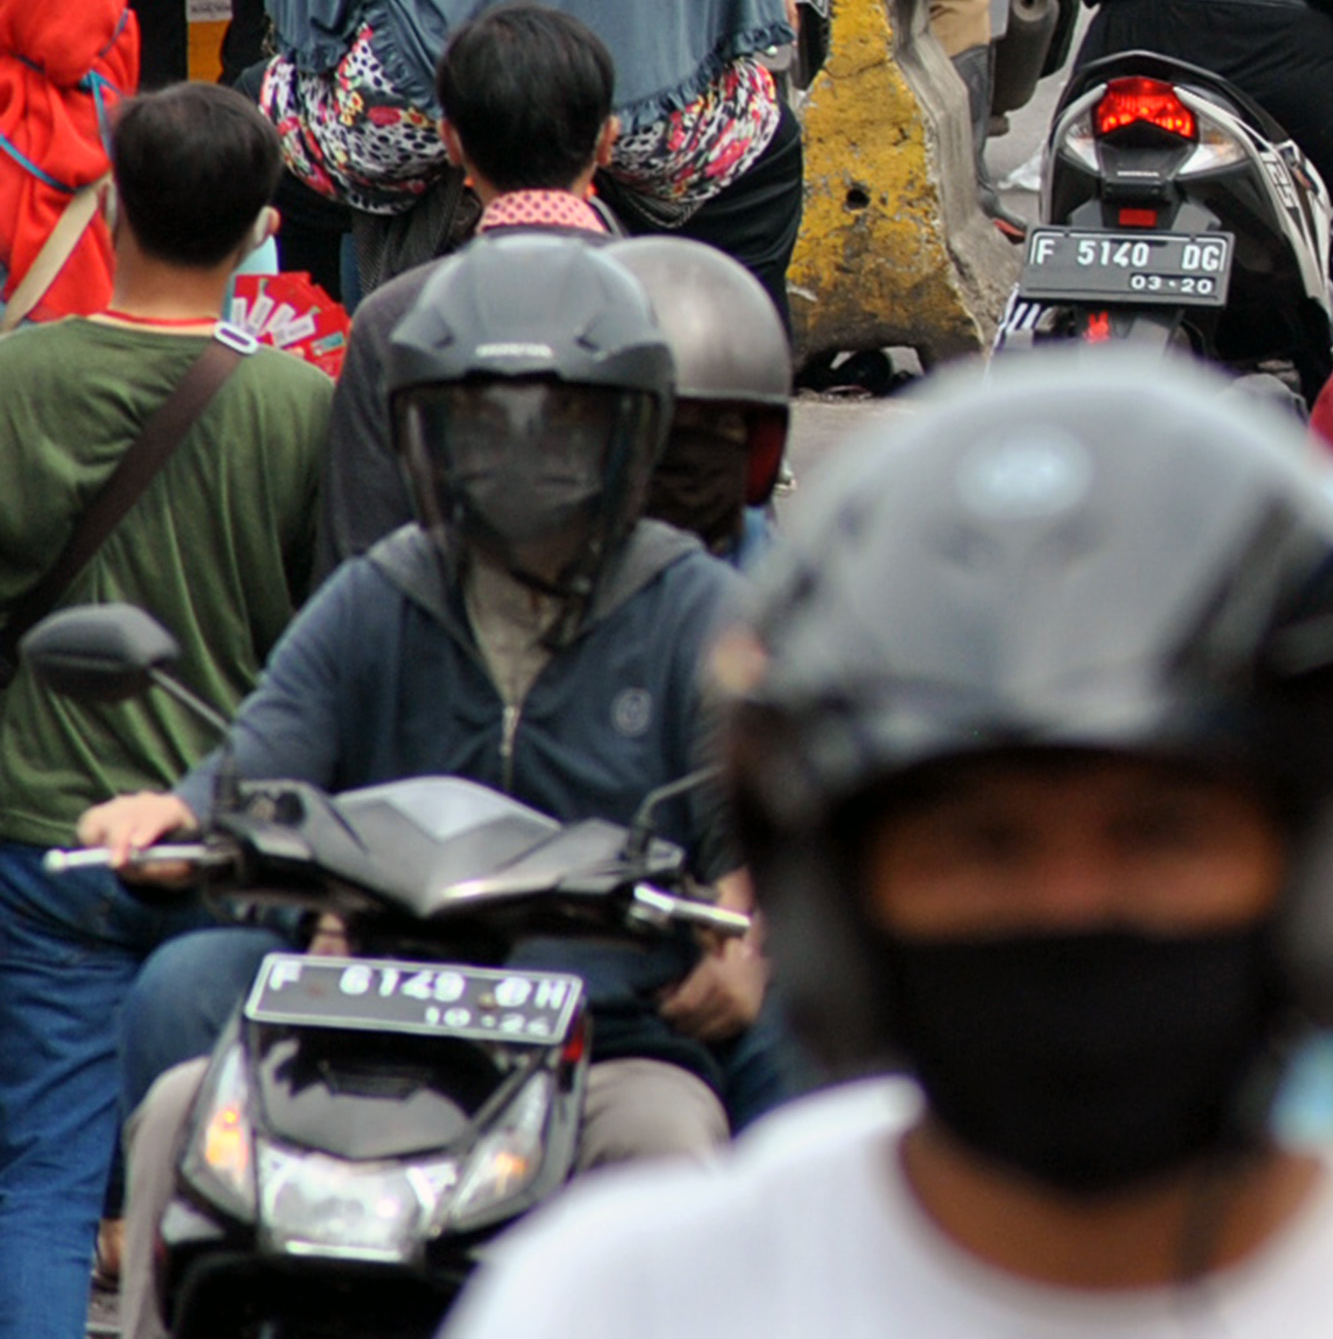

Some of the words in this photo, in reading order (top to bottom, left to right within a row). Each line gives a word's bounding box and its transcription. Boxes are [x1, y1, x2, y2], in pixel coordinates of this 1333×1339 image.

[1036, 239, 1055, 264] F
[1077, 241, 1150, 268] 5140
[1182, 245, 1221, 272] DG
[268, 959, 301, 991] F
